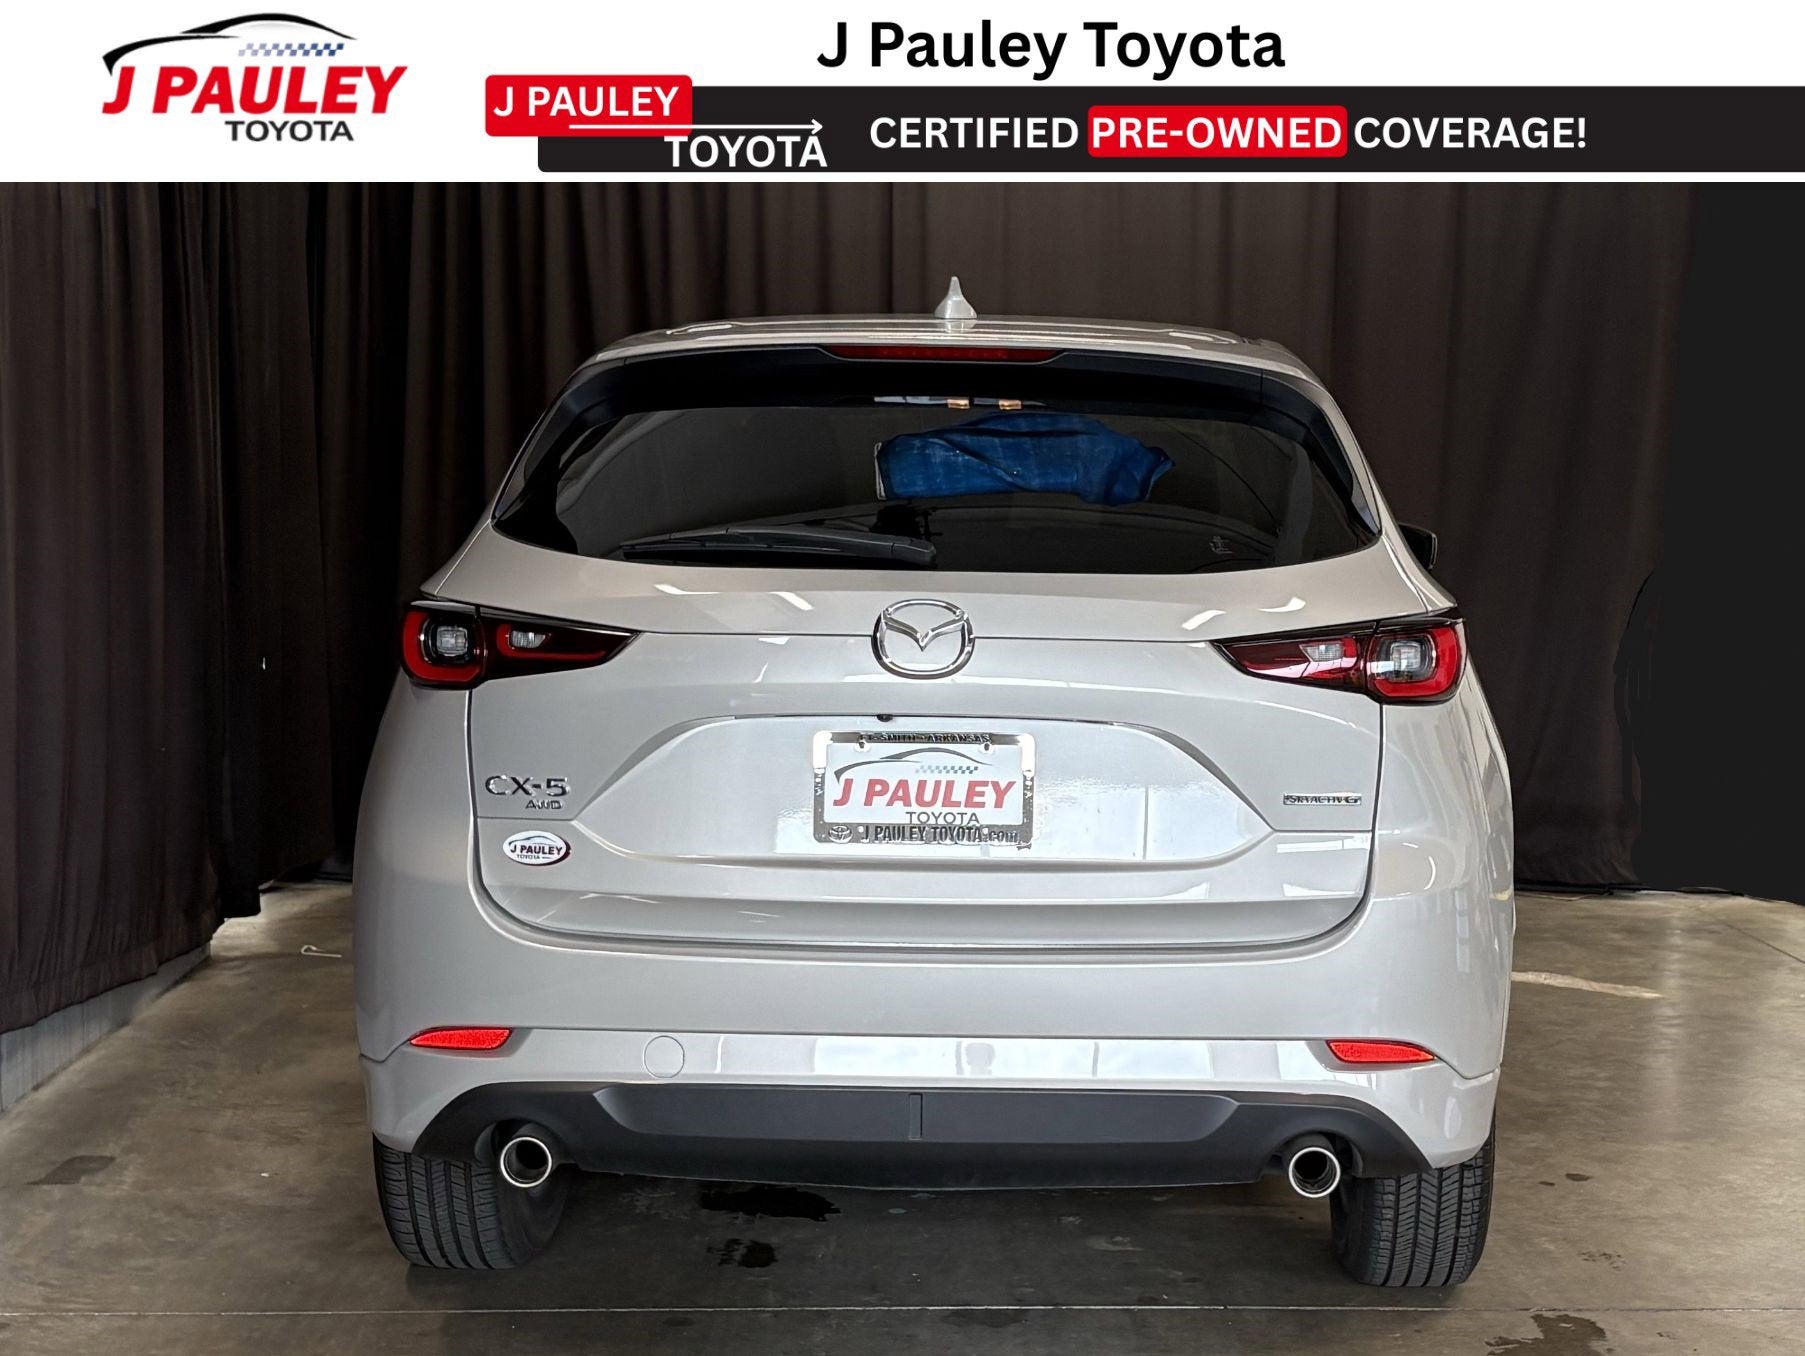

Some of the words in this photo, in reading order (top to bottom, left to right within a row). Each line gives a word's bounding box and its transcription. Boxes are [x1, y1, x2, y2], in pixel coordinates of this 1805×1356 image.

[485, 775, 570, 797] CX-5
[833, 778, 854, 807] J
[863, 778, 1016, 809] PAULEY
[525, 799, 563, 810] AWD
[905, 811, 980, 825] TOYOTA
[861, 825, 870, 842] J
[874, 825, 926, 843] PAULEY
[510, 845, 517, 853] J
[520, 845, 563, 855] PAULEY
